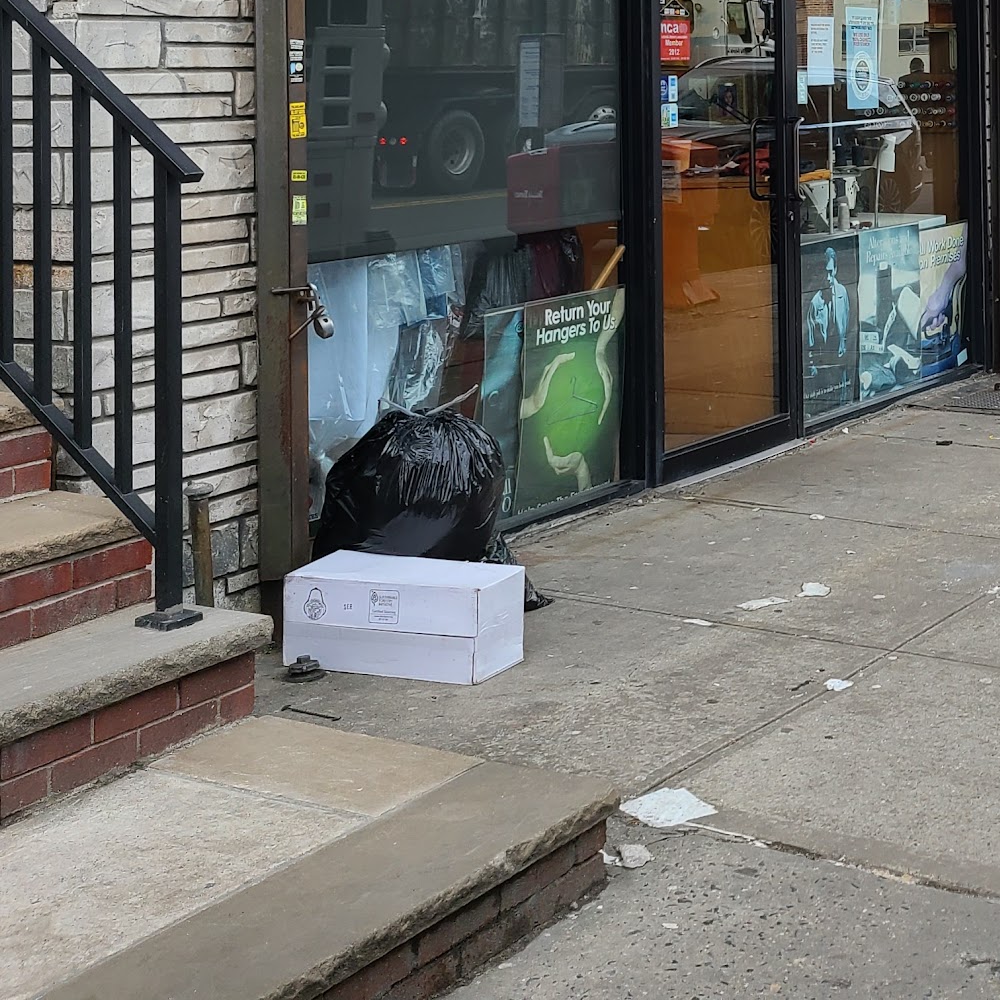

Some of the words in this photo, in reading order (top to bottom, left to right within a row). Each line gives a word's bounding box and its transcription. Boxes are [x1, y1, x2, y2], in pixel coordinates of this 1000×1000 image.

[665, 39, 683, 47] Member
[927, 239, 947, 254] Work
[947, 236, 964, 251] Done
[930, 250, 961, 268] Premises
[545, 305, 584, 326] Return
[586, 300, 611, 317] Your
[536, 323, 586, 346] Hangers
[588, 317, 600, 334] To
